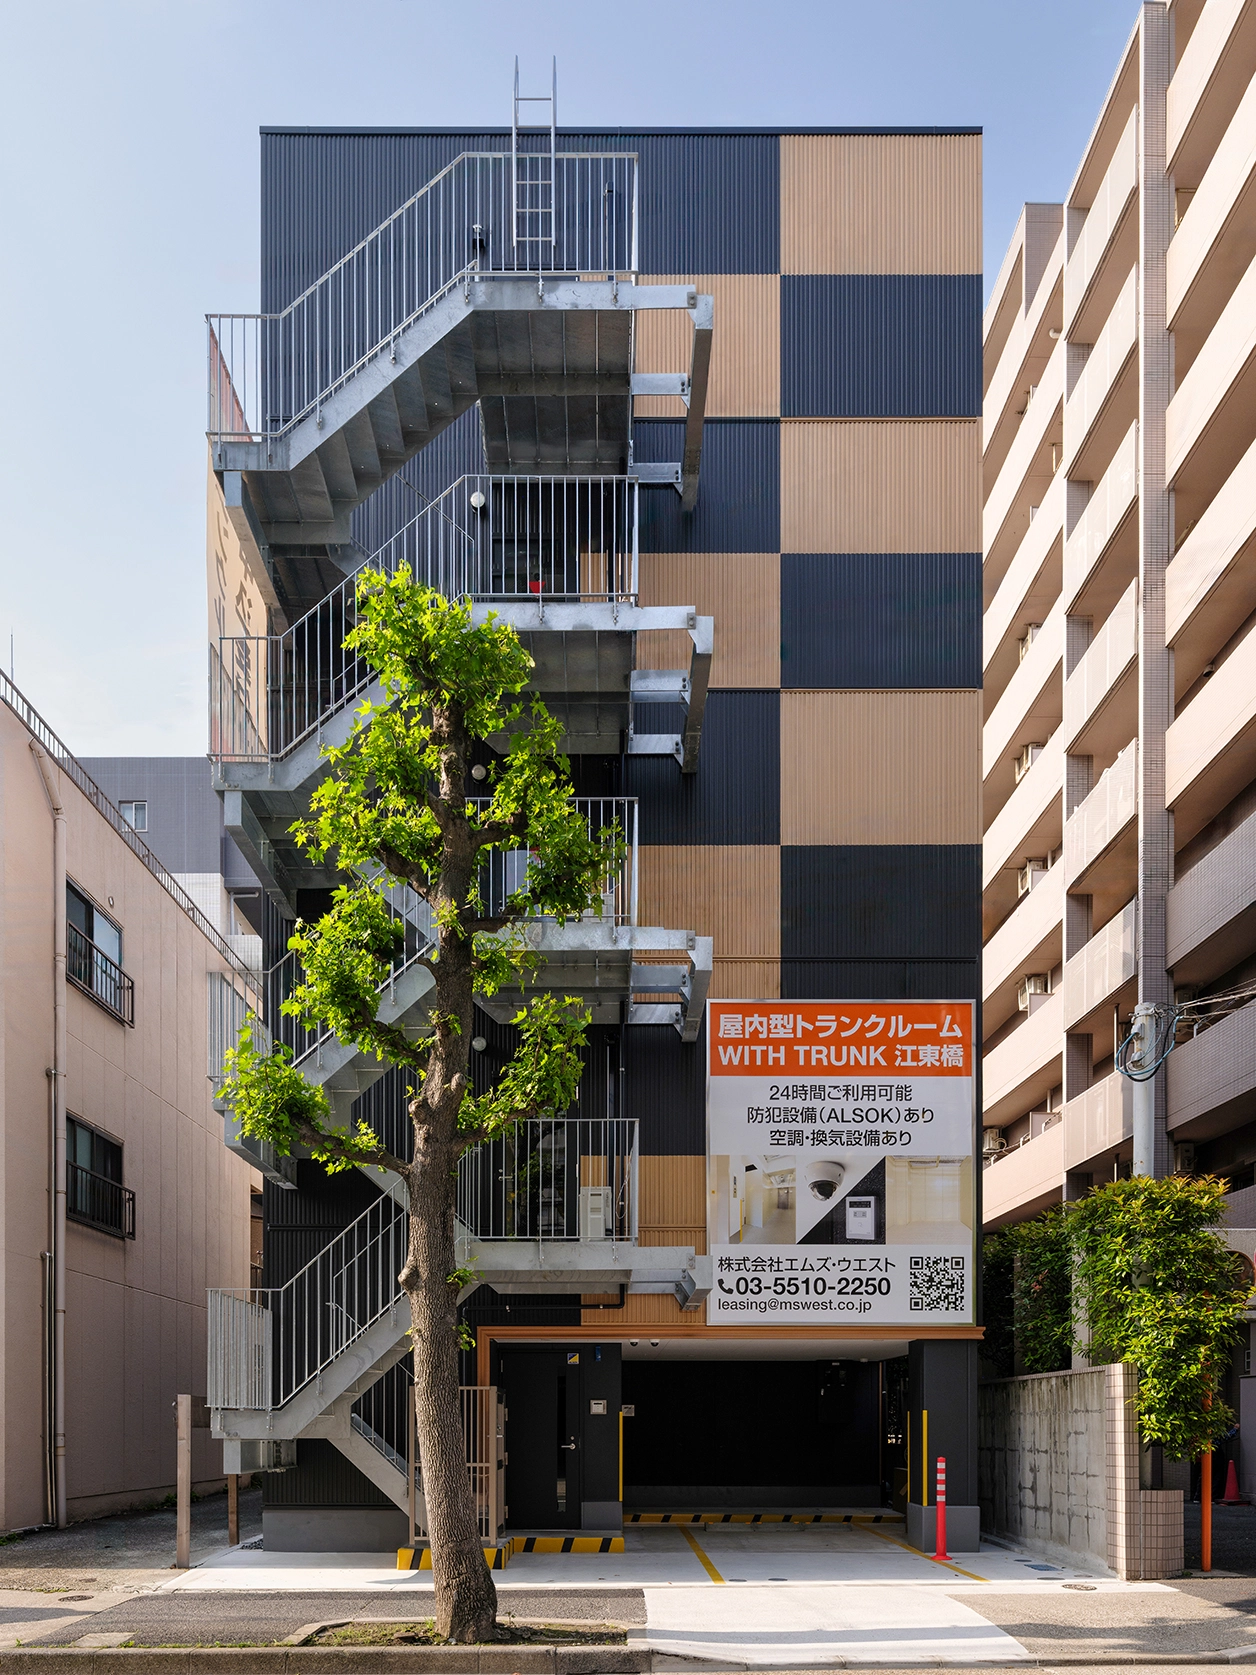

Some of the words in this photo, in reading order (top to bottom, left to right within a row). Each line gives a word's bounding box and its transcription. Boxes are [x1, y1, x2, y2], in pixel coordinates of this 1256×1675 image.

[717, 1013, 963, 1039] 屋内型トランクルーム
[717, 1045, 785, 1066] WITH
[793, 1045, 888, 1067] TRUNK
[894, 1043, 964, 1068] 江東橋
[769, 1083, 913, 1102] 24時間ご利用可能
[747, 1106, 935, 1125] 防犯設備（ALSOK）あり
[769, 1128, 912, 1147] 空調・換気設備あり
[717, 1256, 896, 1273] 株式会社エムズ・ウエスト
[735, 1276, 891, 1296] 03-5510-2250
[718, 1298, 872, 1314] leasing@mswest.co.jp
